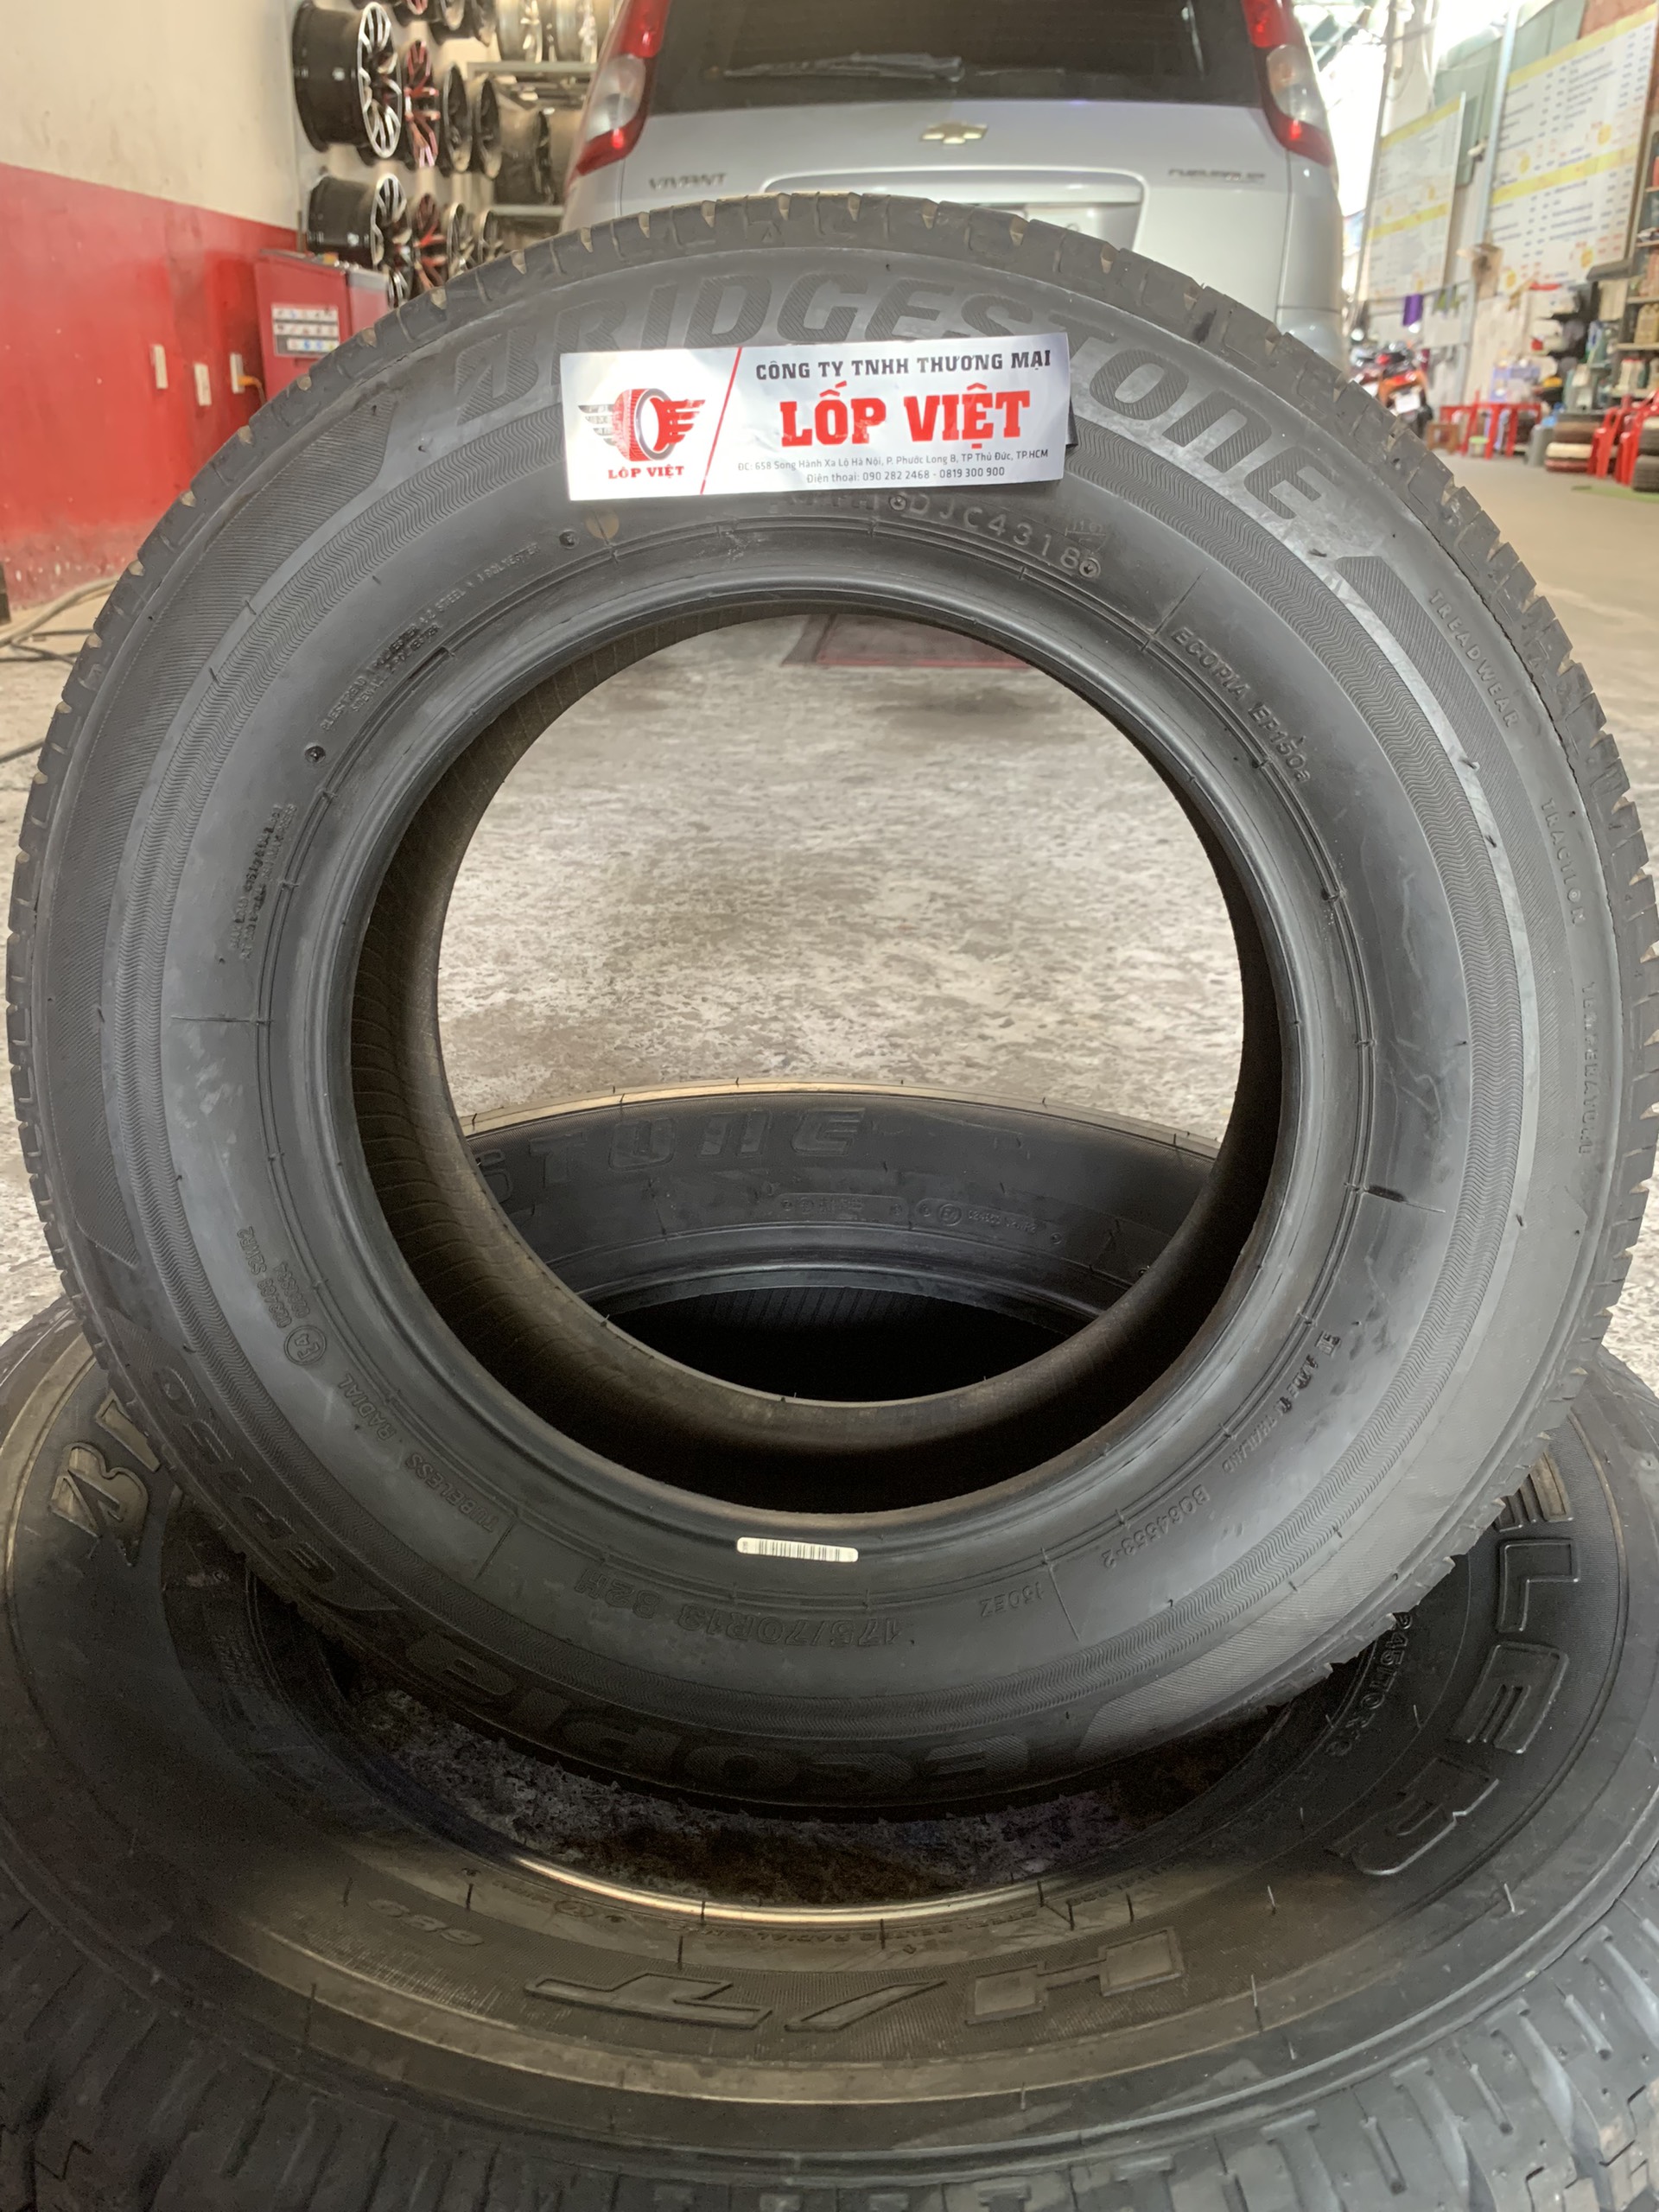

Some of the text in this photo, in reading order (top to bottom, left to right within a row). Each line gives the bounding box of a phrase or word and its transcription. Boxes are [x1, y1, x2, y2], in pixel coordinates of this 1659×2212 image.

[756, 350, 1052, 380] CÔNG TY TNHH THƯƠNG MẠI
[779, 380, 1031, 449] LỐP VIỆT
[647, 465, 685, 479] VIỆT
[738, 462, 753, 471] ĐC:
[755, 461, 772, 470] 658
[774, 460, 797, 471] Song
[798, 459, 822, 468] Hành
[851, 457, 863, 467] Hà
[887, 456, 894, 465] P.
[926, 454, 948, 466] Long
[961, 453, 973, 462] TP
[976, 451, 992, 461] Thủ
[807, 474, 830, 483] Điện
[832, 472, 860, 483] thoại:
[862, 471, 882, 481] 090
[884, 470, 903, 480] 282
[905, 469, 931, 480] 2468
[939, 467, 963, 479] 0819
[965, 467, 984, 477] 300
[986, 466, 1006, 476] 900
[1171, 626, 1250, 701] ECOPIA
[1428, 588, 1517, 728] TREADWEAR
[1541, 798, 1587, 925] TRACTION
[336, 1378, 397, 1442] RADIAL
[1218, 1412, 1278, 1477] THAILAND
[405, 1452, 500, 1534] TUBELESS
[574, 1567, 901, 1647] 175/70R13 82H
